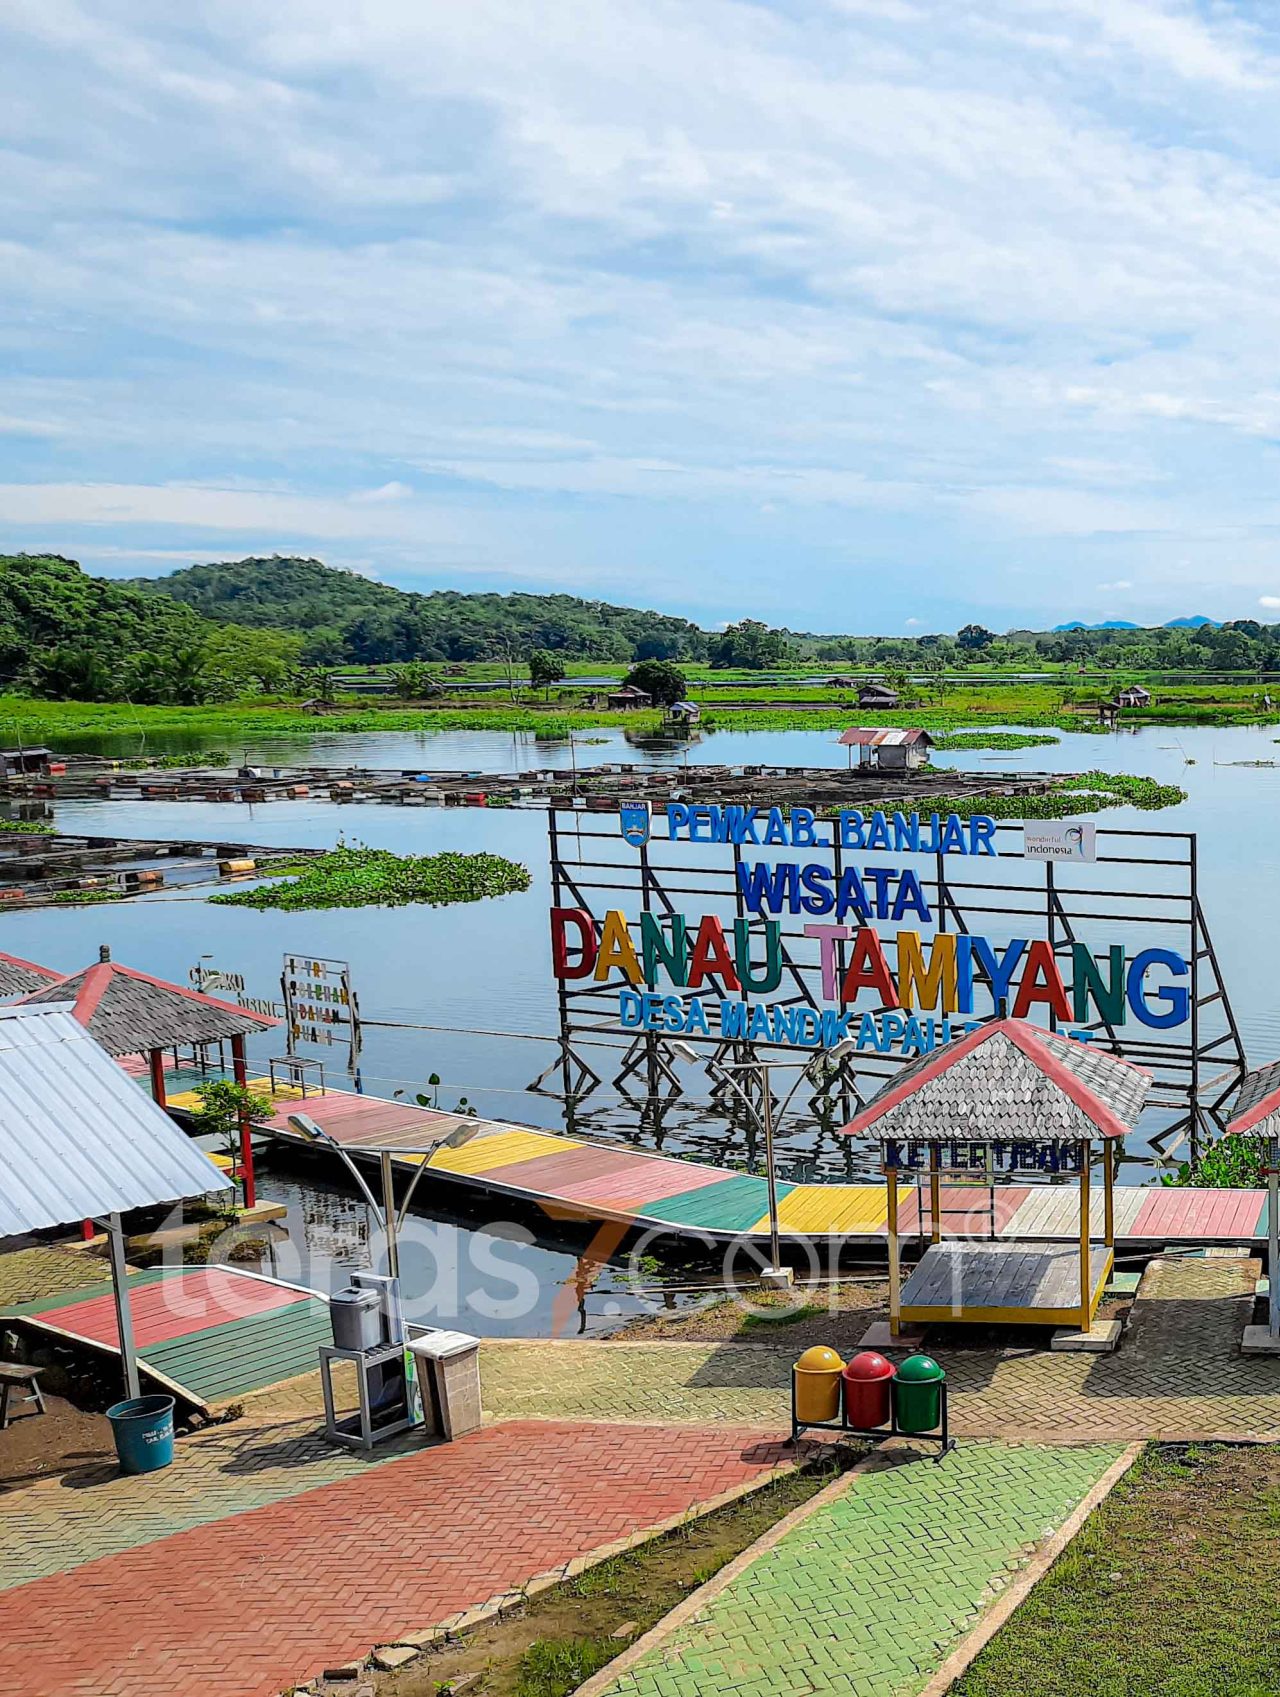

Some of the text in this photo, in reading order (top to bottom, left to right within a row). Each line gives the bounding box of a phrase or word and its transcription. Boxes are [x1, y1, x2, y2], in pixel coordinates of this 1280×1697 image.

[621, 802, 646, 811] BANJAR
[666, 803, 998, 857] PEMKAB. BANJAR
[1027, 844, 1072, 855] indonesia
[737, 860, 933, 922] WISATA
[550, 907, 1191, 1030] DANAU TAMIYANG
[619, 990, 711, 1035] DESA
